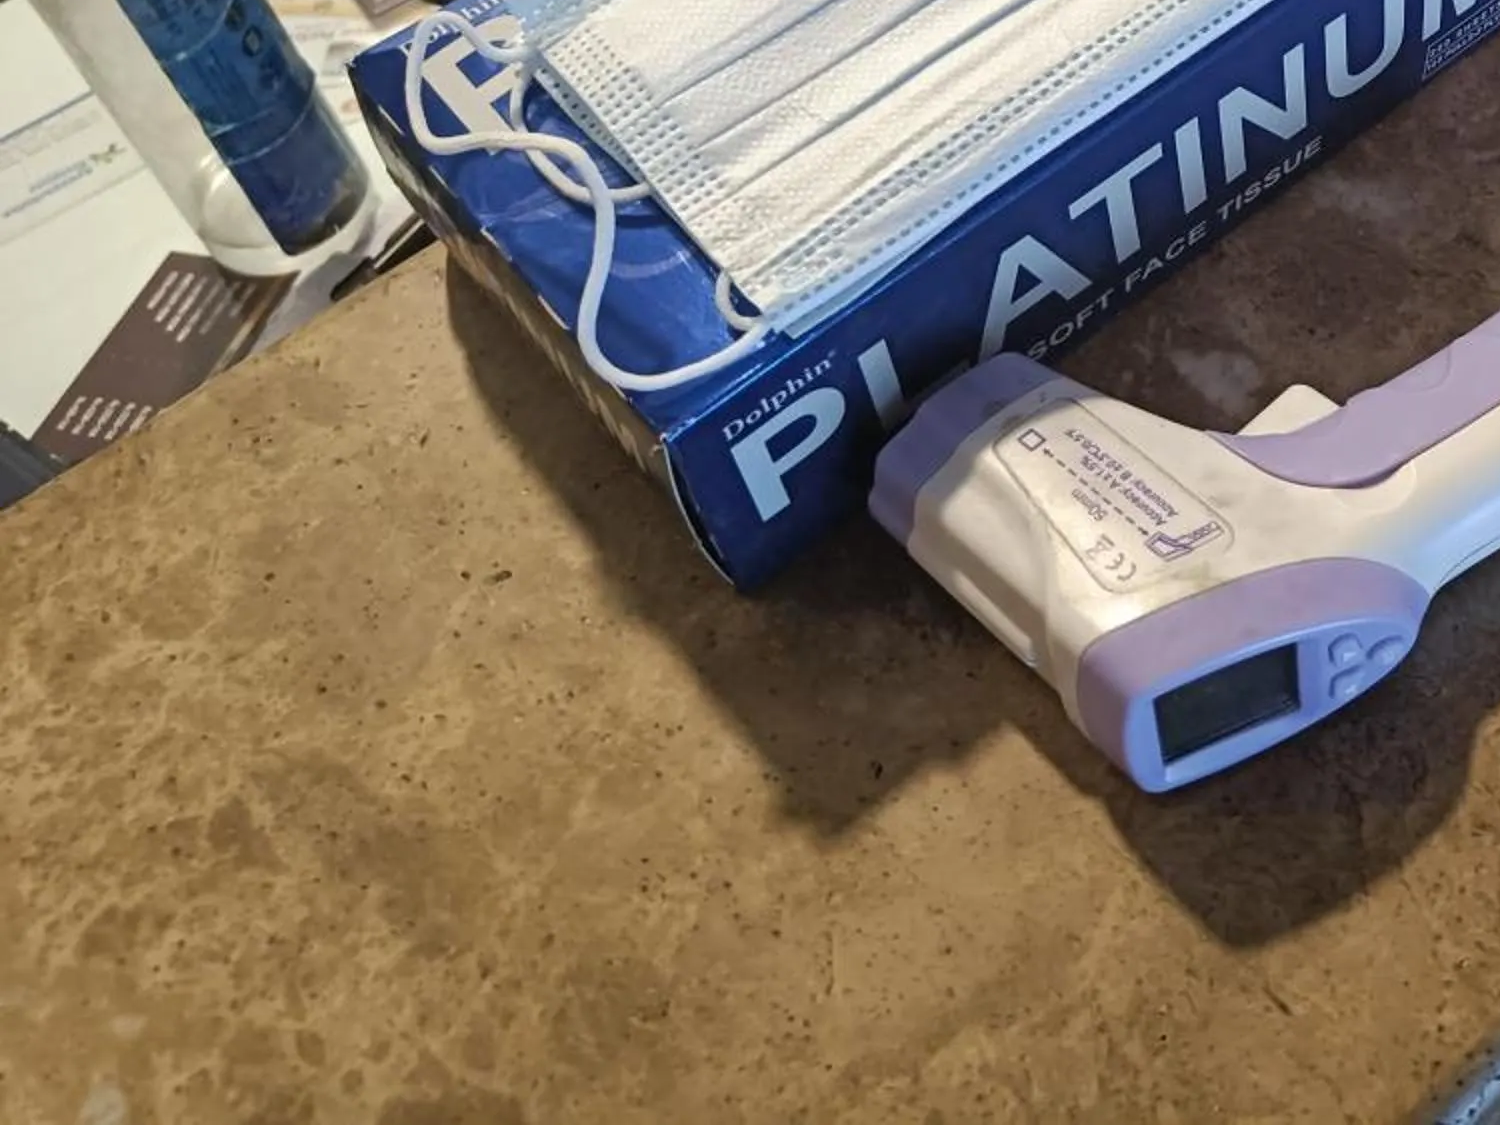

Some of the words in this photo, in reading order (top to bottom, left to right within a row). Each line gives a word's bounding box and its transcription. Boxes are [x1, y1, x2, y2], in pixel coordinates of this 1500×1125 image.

[1027, 287, 1115, 361] SOFT
[1123, 220, 1207, 293] FACE
[1216, 134, 1326, 221] TISSUE
[722, 358, 832, 441] Dolphin
